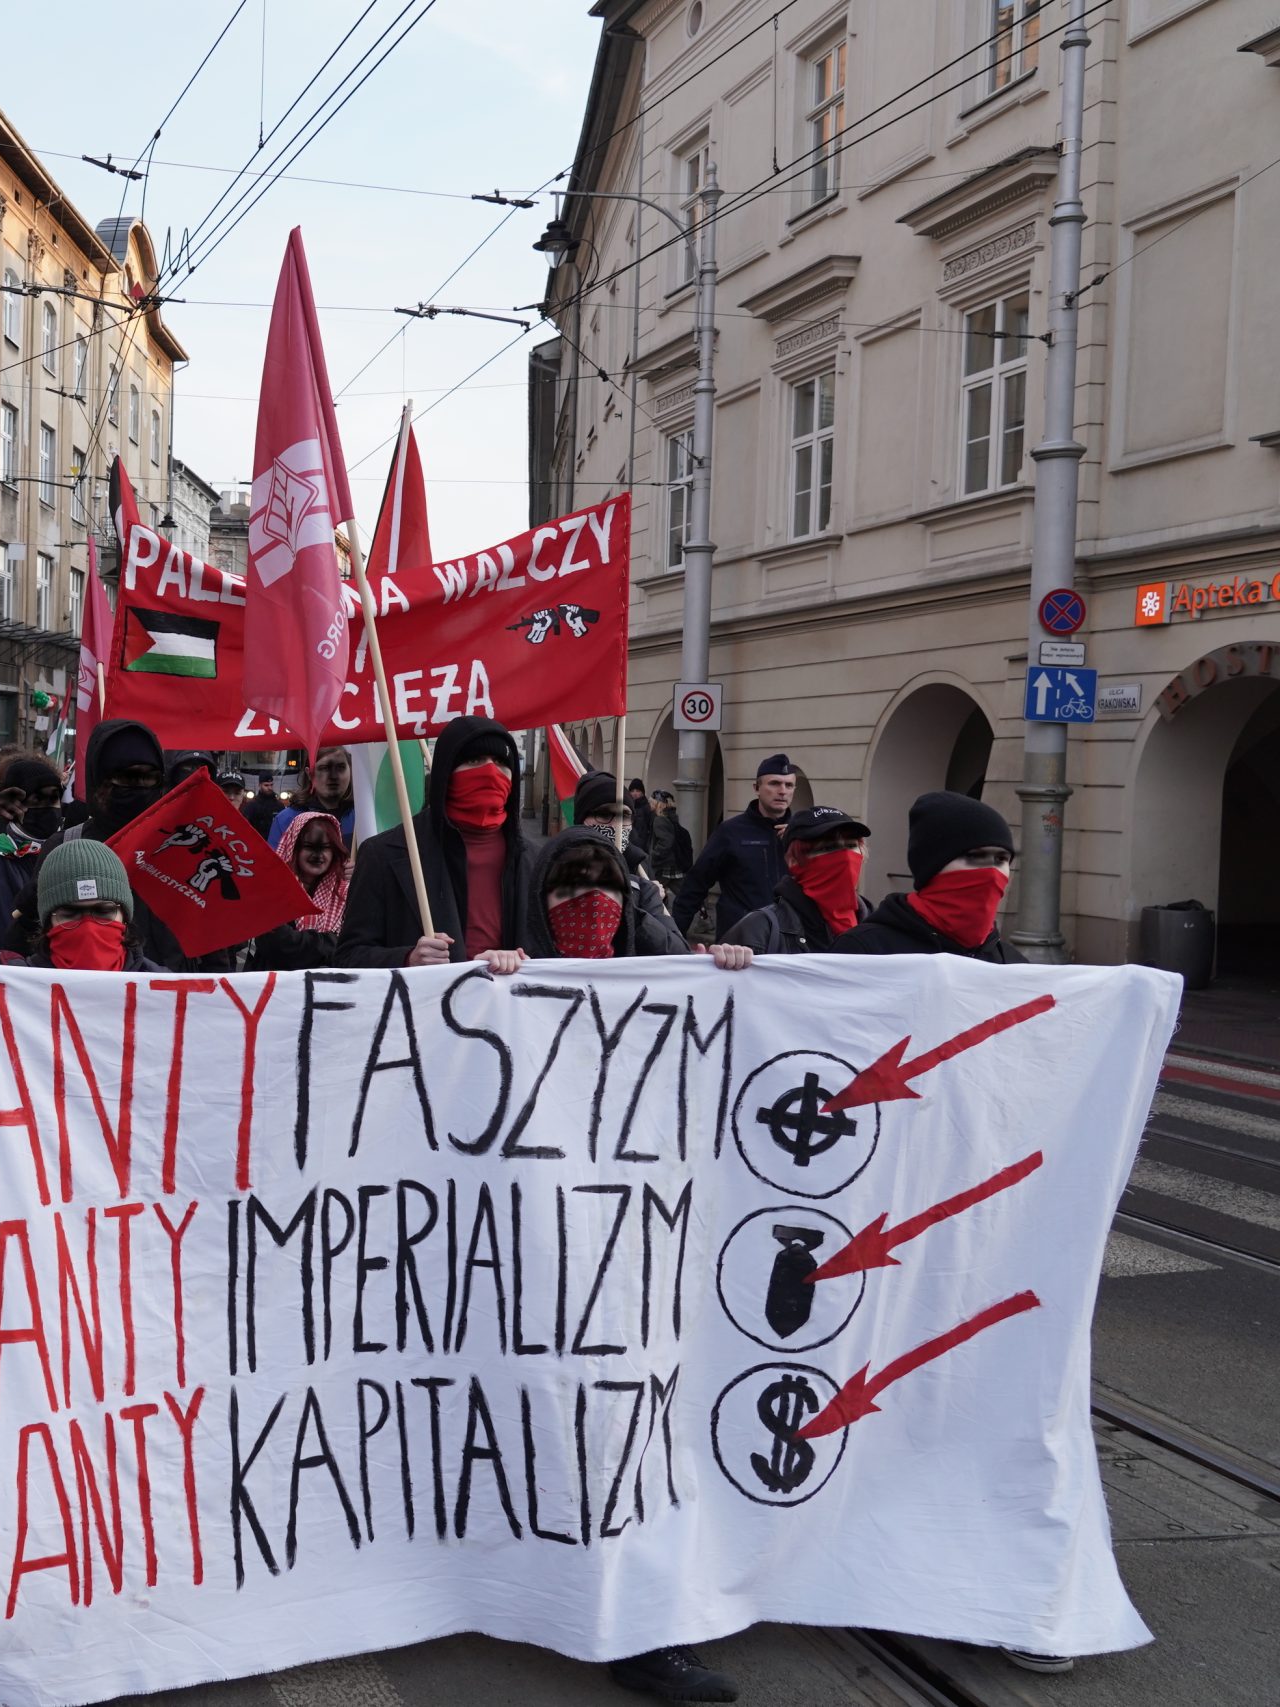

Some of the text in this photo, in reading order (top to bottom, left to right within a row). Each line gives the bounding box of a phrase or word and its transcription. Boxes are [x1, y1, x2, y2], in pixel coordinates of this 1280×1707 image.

[123, 503, 616, 618] PALENA WALCZY
[1174, 575, 1263, 620] Apteka
[686, 699, 709, 715] 30
[196, 815, 254, 878] AKCJA
